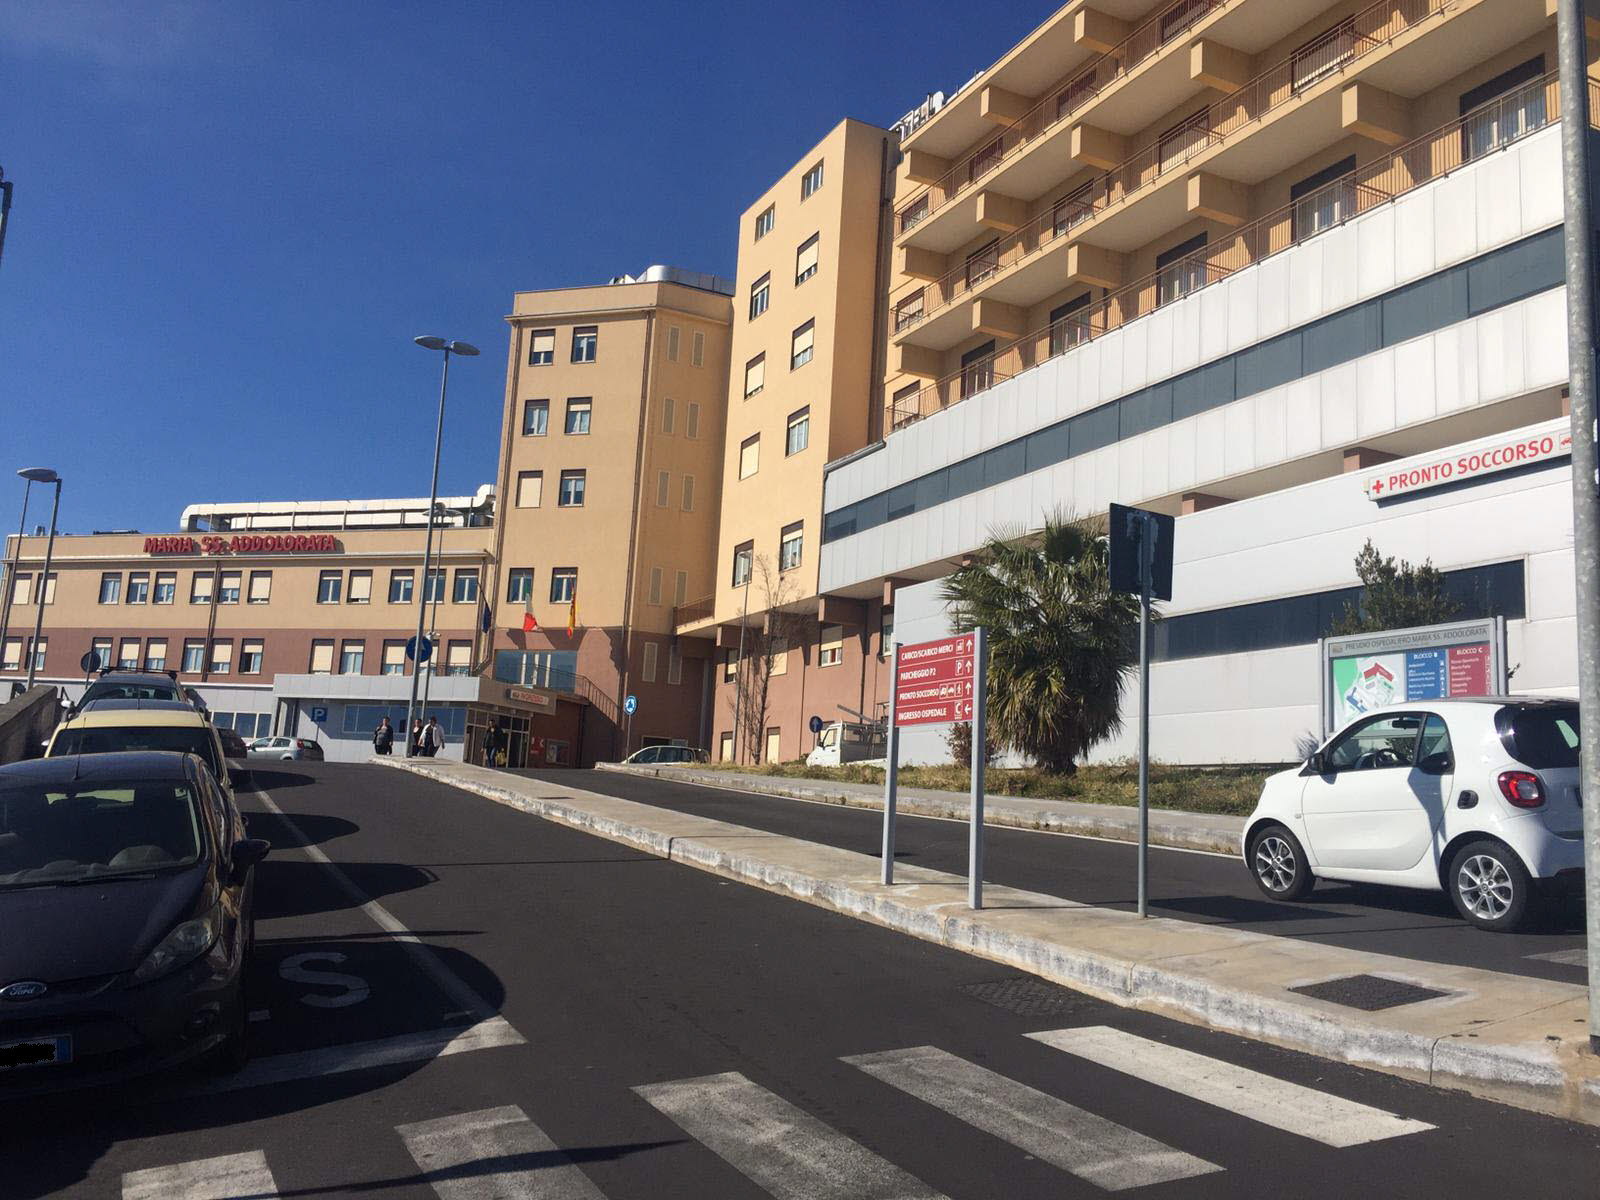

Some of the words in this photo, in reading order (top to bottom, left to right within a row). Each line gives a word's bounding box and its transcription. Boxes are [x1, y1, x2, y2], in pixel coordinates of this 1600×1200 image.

[1389, 462, 1453, 491] PRONTO
[1457, 437, 1554, 475] SOCCORSO
[143, 537, 194, 553] MARIA
[229, 534, 336, 552] ADDOLORATA
[900, 670, 929, 681] PARCHEGGIO
[929, 667, 936, 676] P2
[899, 691, 916, 700] PRONTO
[916, 688, 939, 698] SOCCORSO
[314, 708, 325, 721] P
[898, 710, 921, 720] INGRESSO
[921, 707, 946, 718] OSPEDALE
[9, 985, 36, 996] Ford
